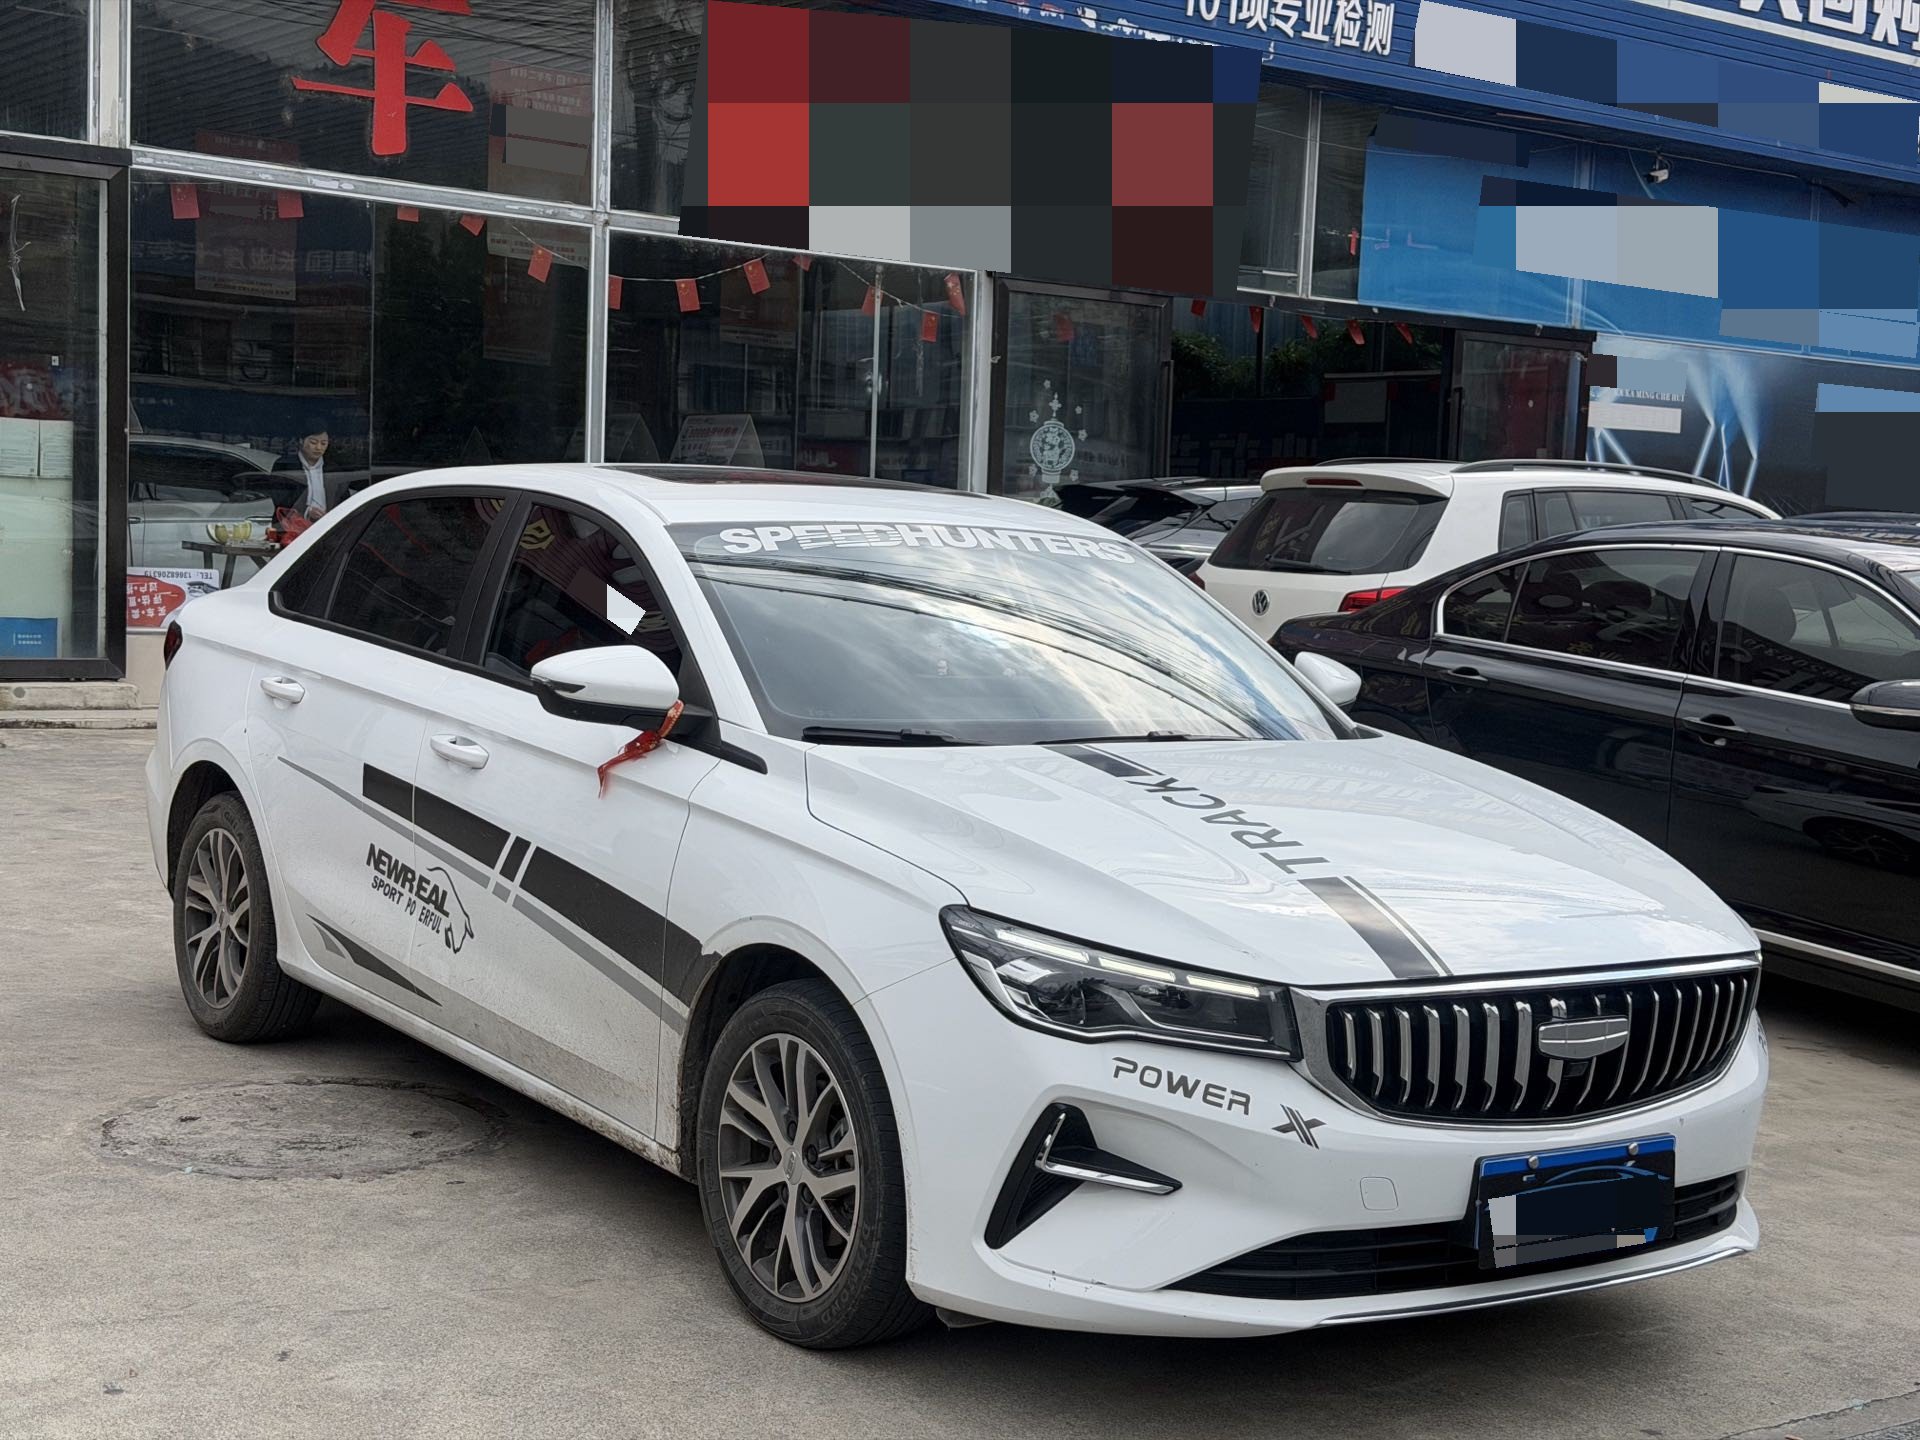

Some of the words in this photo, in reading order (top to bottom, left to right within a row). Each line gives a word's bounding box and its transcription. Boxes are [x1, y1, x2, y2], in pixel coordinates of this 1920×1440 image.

[718, 524, 1136, 564] SPEEDHUNTERS
[1126, 776, 1330, 875] TRACK
[366, 843, 450, 919] NEWREAL
[371, 875, 404, 905] SPORT
[1112, 1056, 1251, 1116] POWER
